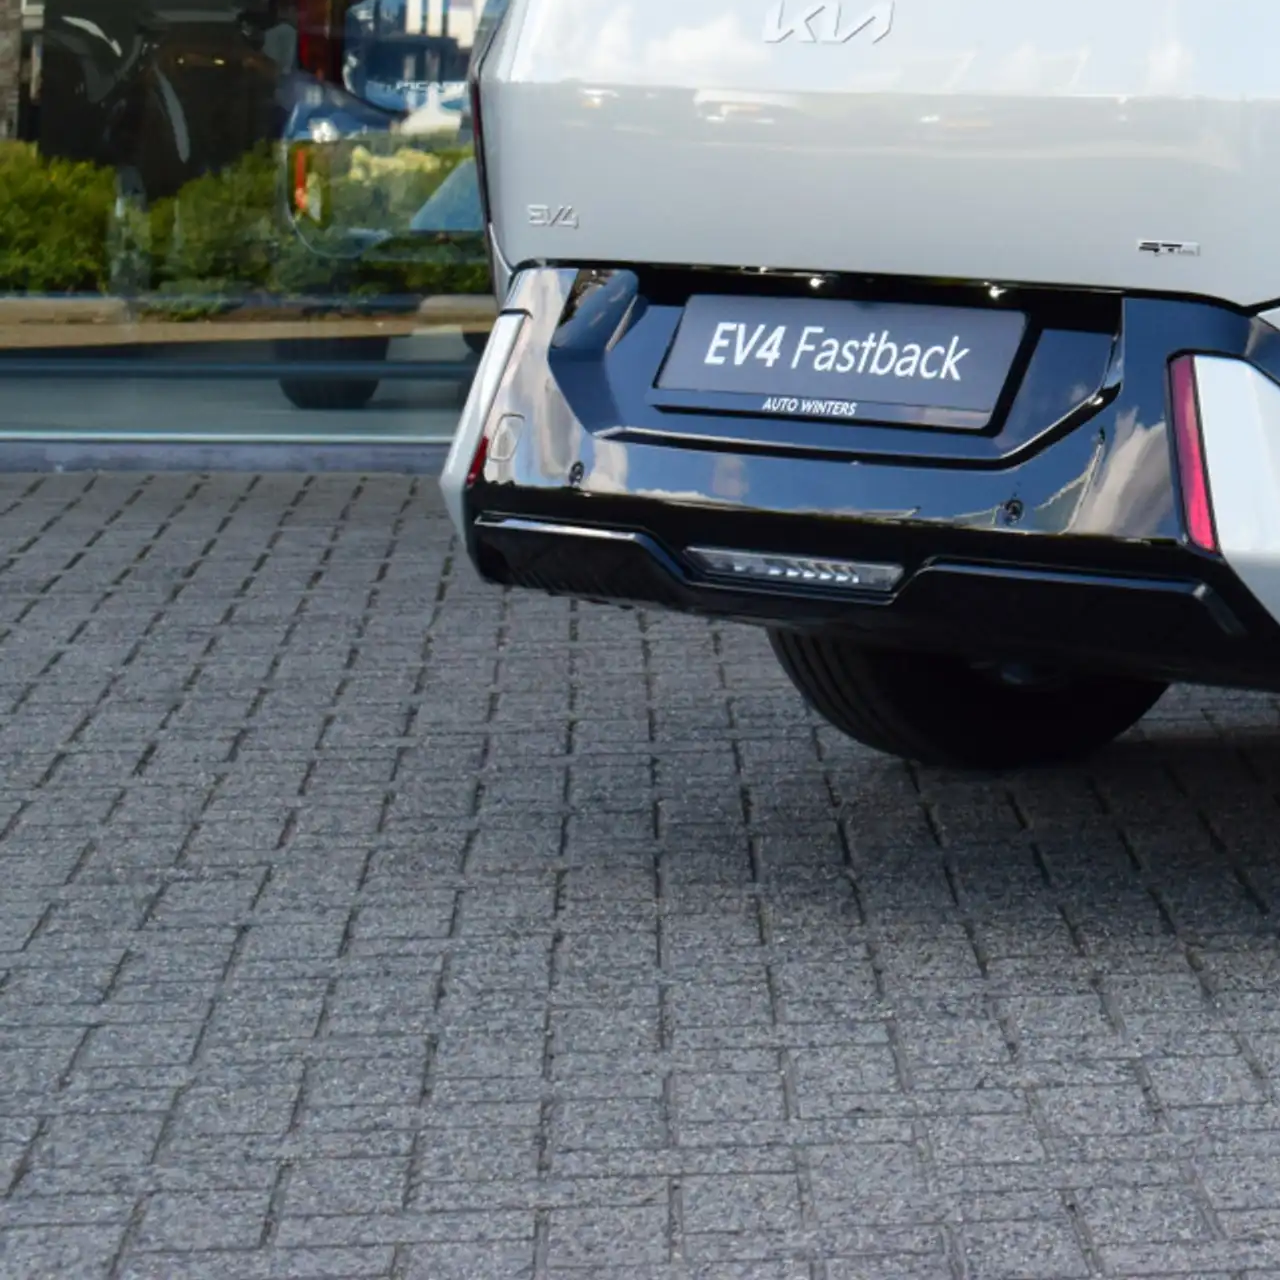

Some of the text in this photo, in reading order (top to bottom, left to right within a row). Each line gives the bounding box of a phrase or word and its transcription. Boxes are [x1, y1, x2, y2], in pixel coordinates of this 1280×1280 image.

[704, 321, 970, 381] EV4 Fastback
[761, 396, 858, 417] AUTO WINTERS
